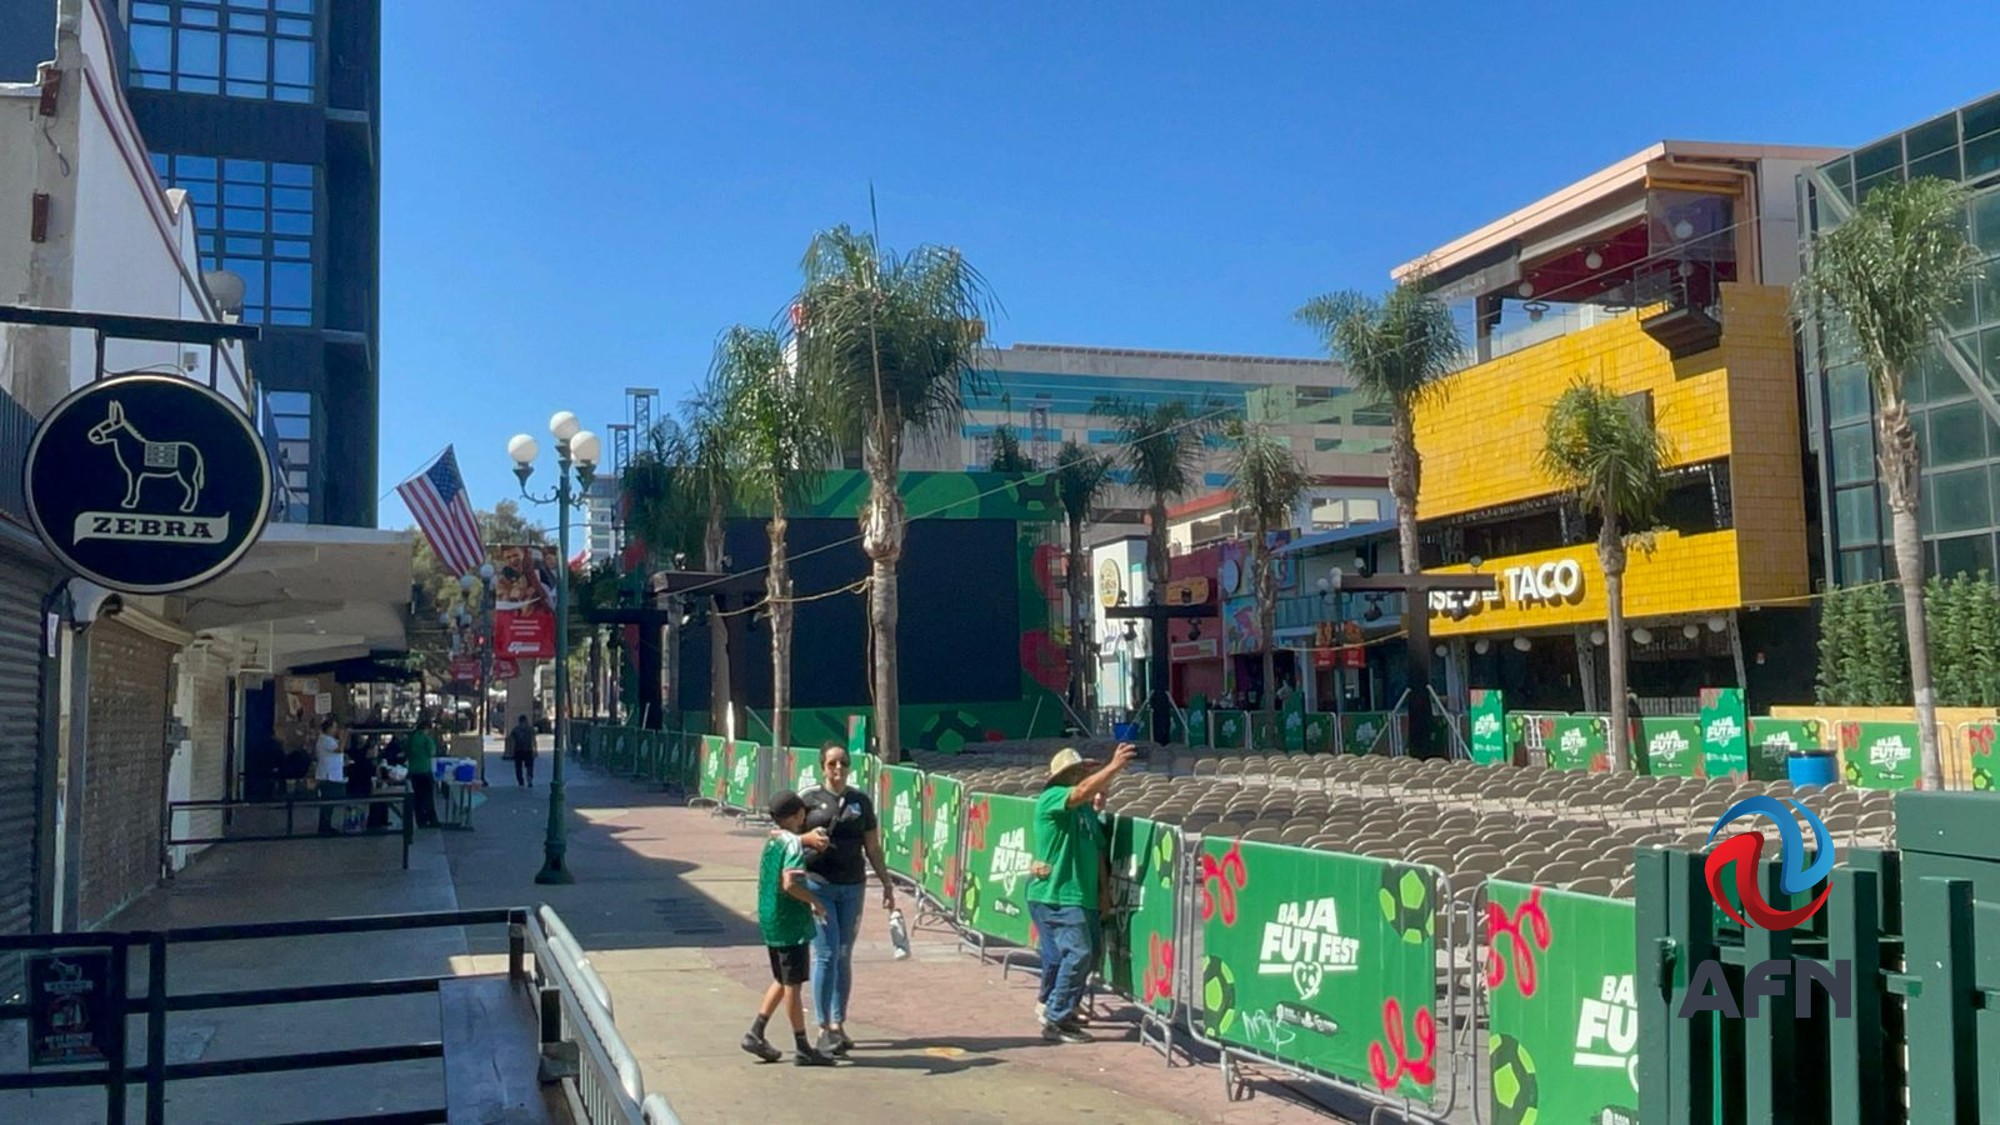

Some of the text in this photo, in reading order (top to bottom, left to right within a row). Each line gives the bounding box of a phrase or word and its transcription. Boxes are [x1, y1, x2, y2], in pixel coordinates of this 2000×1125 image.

[93, 517, 213, 538] ZEBRA
[1504, 559, 1580, 601] TACO
[1277, 897, 1339, 935] BAJA
[1601, 975, 1638, 1009] BA
[1576, 997, 1638, 1053] FU
